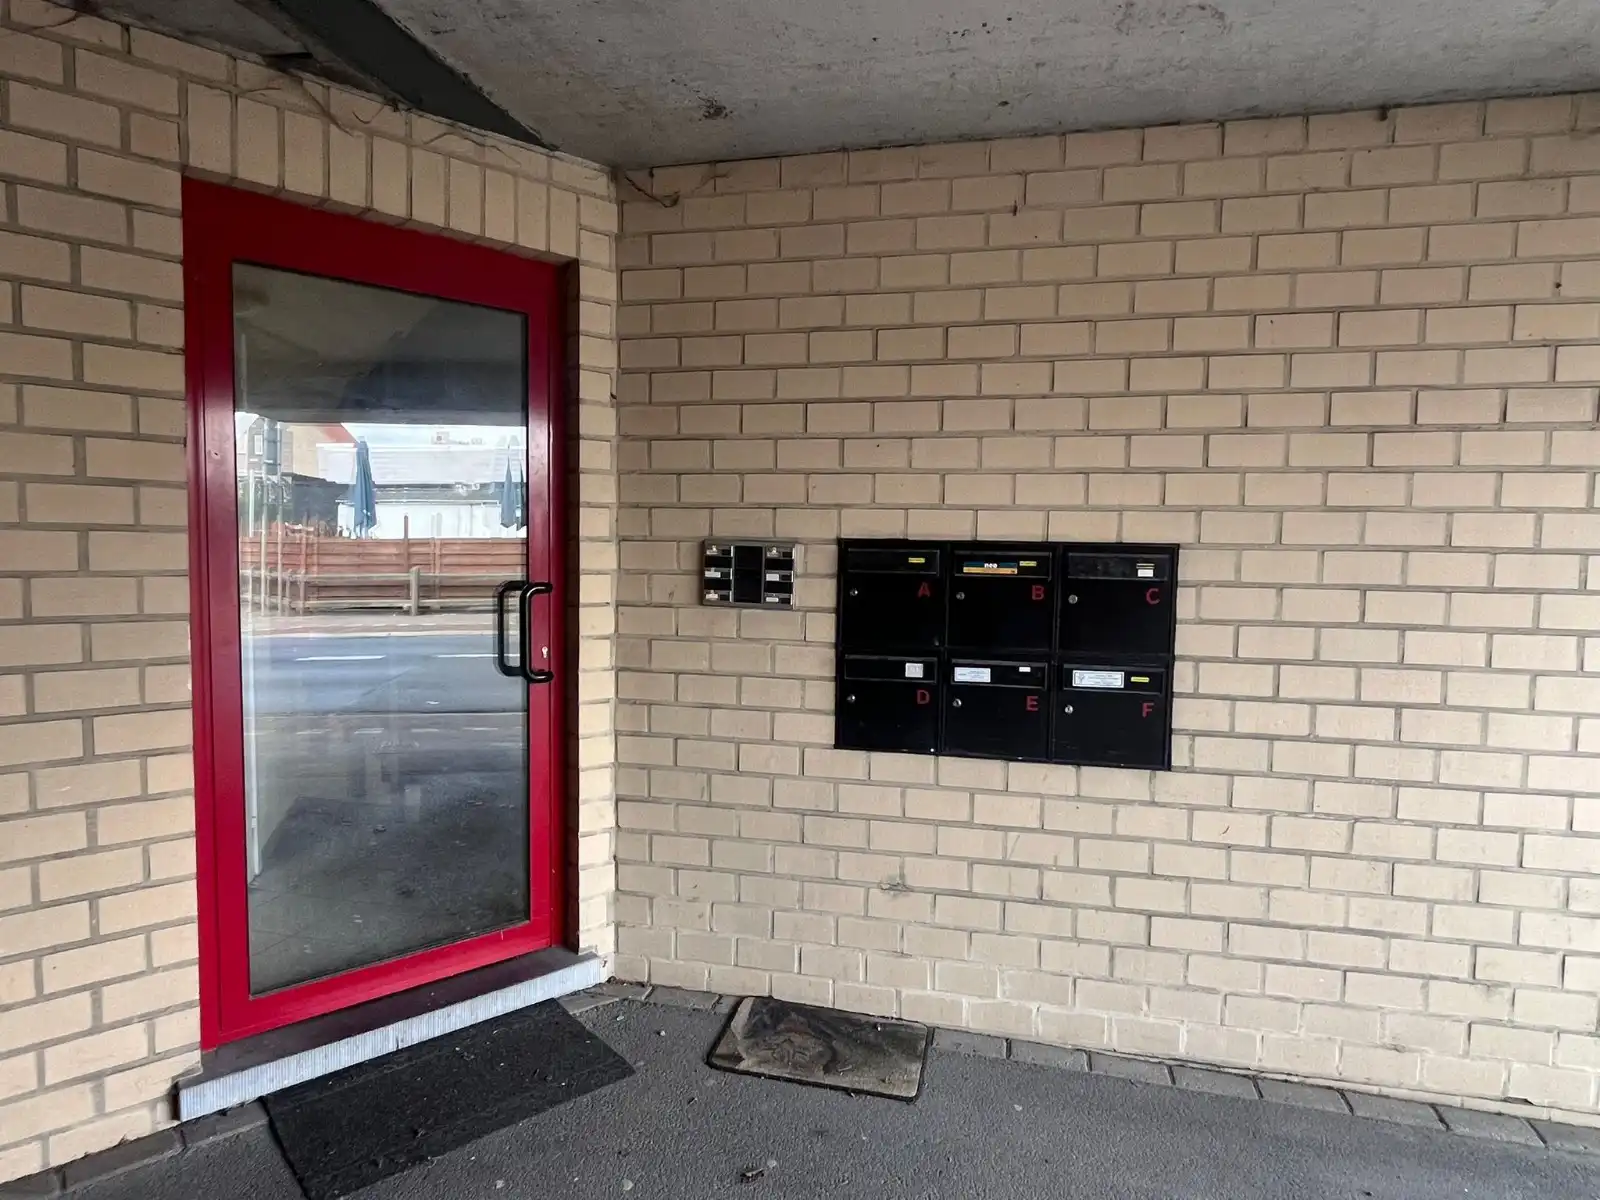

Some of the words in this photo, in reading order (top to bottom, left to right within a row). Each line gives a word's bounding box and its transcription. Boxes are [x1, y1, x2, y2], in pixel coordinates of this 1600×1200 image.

[918, 582, 931, 597] A
[1031, 585, 1045, 600] B
[1146, 587, 1160, 604] C
[917, 689, 930, 704] D
[1026, 695, 1039, 711] E
[1142, 702, 1155, 718] F
